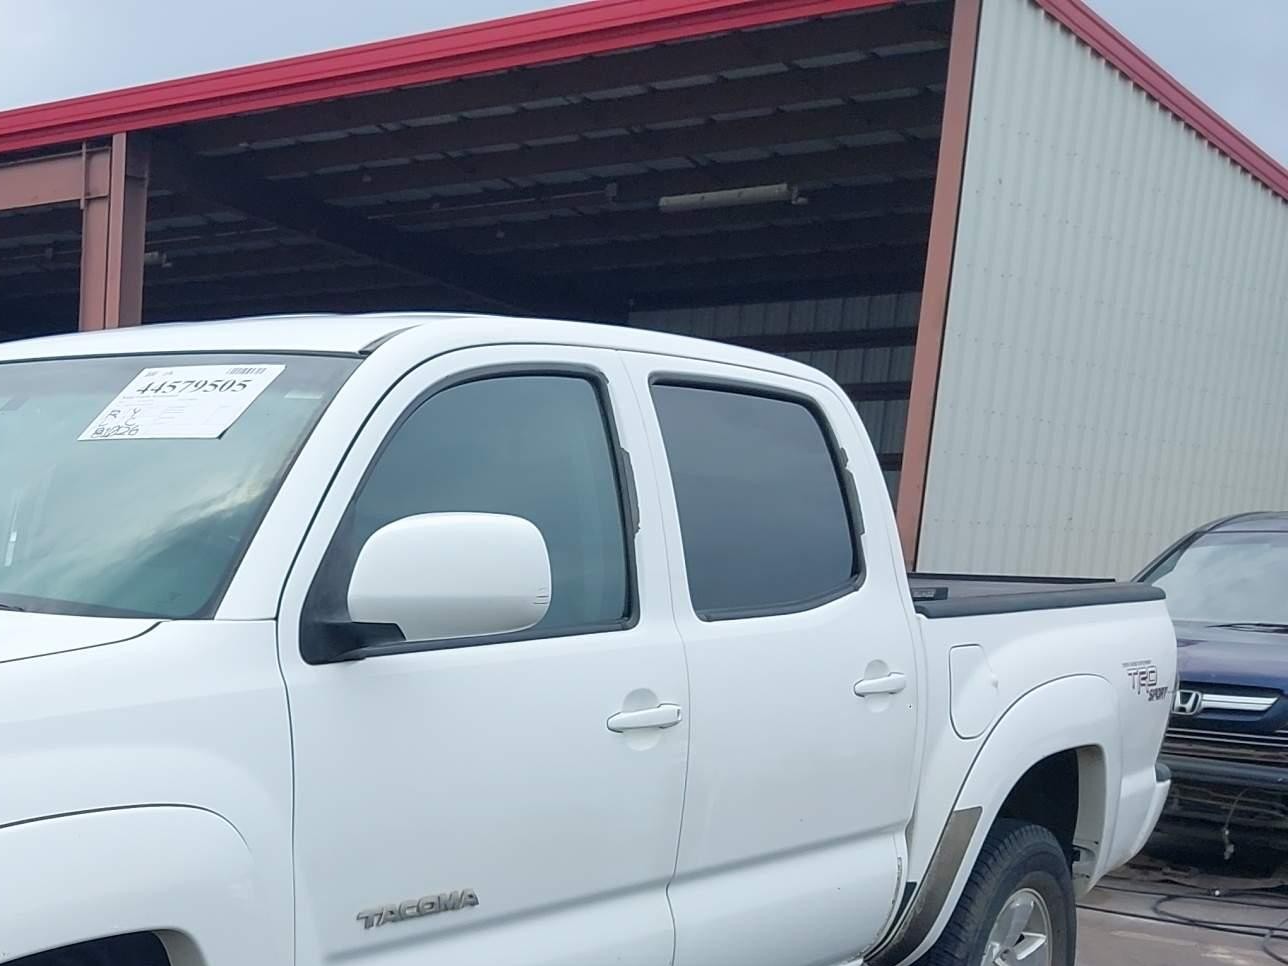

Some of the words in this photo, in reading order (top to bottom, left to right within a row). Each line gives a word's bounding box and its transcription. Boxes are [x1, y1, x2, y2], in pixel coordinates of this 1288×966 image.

[136, 379, 252, 394] 44579505
[1127, 665, 1158, 695] TRD
[1146, 687, 1169, 702] SPORT
[356, 888, 480, 930] TACOMA
